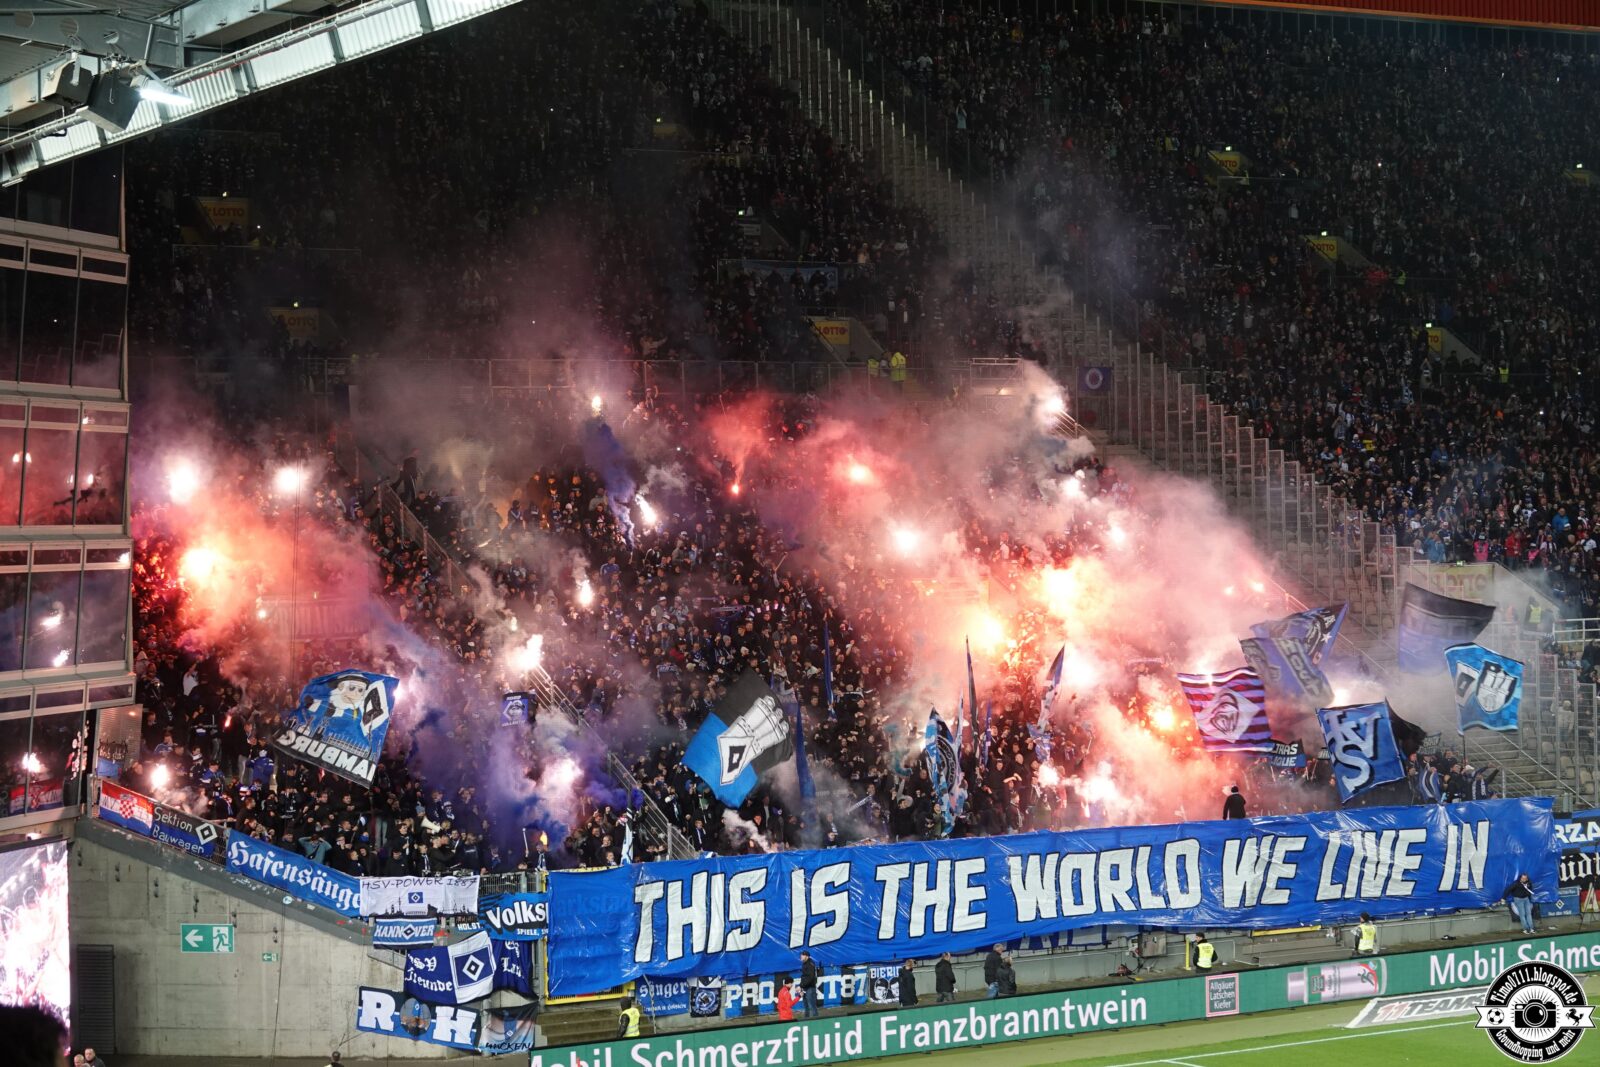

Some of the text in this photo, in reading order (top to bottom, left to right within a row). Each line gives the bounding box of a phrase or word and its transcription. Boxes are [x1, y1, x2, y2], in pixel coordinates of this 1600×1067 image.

[154, 806, 193, 833] Sektion
[152, 825, 205, 854] Bauwagen
[446, 876, 477, 888] 1887
[634, 820, 1491, 964] THIS IS THE WORLD WE LIVE IN
[486, 900, 549, 929] Volks
[1430, 946, 1505, 986] Mobil
[1210, 990, 1236, 1001] Latschen
[1213, 1000, 1232, 1009] Kiefer
[630, 1019, 863, 1067] Schmerzfluid
[880, 989, 1147, 1051] Franzbranntwein
